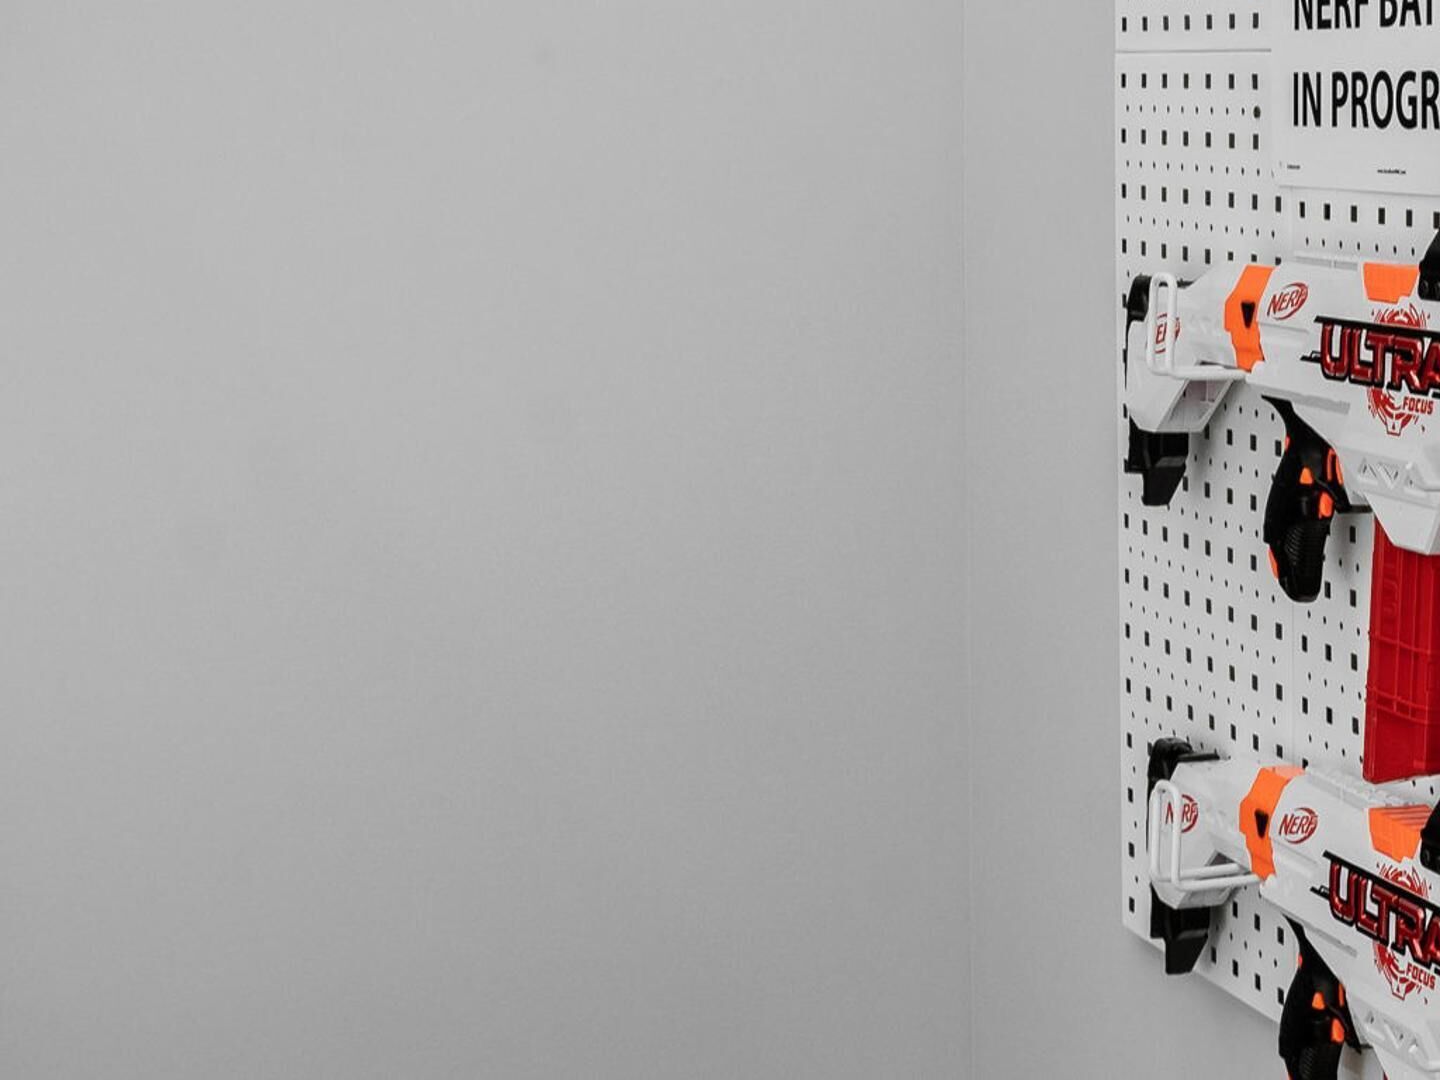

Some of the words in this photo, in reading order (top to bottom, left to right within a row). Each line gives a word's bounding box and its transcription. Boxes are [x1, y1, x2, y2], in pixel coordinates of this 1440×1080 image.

[1293, 71, 1322, 127] IN
[1267, 285, 1309, 317] NERF
[1402, 396, 1435, 415] FOCUS
[1165, 801, 1198, 824] NRF
[1279, 812, 1319, 836] NERF
[1405, 962, 1437, 990] FOCUS
